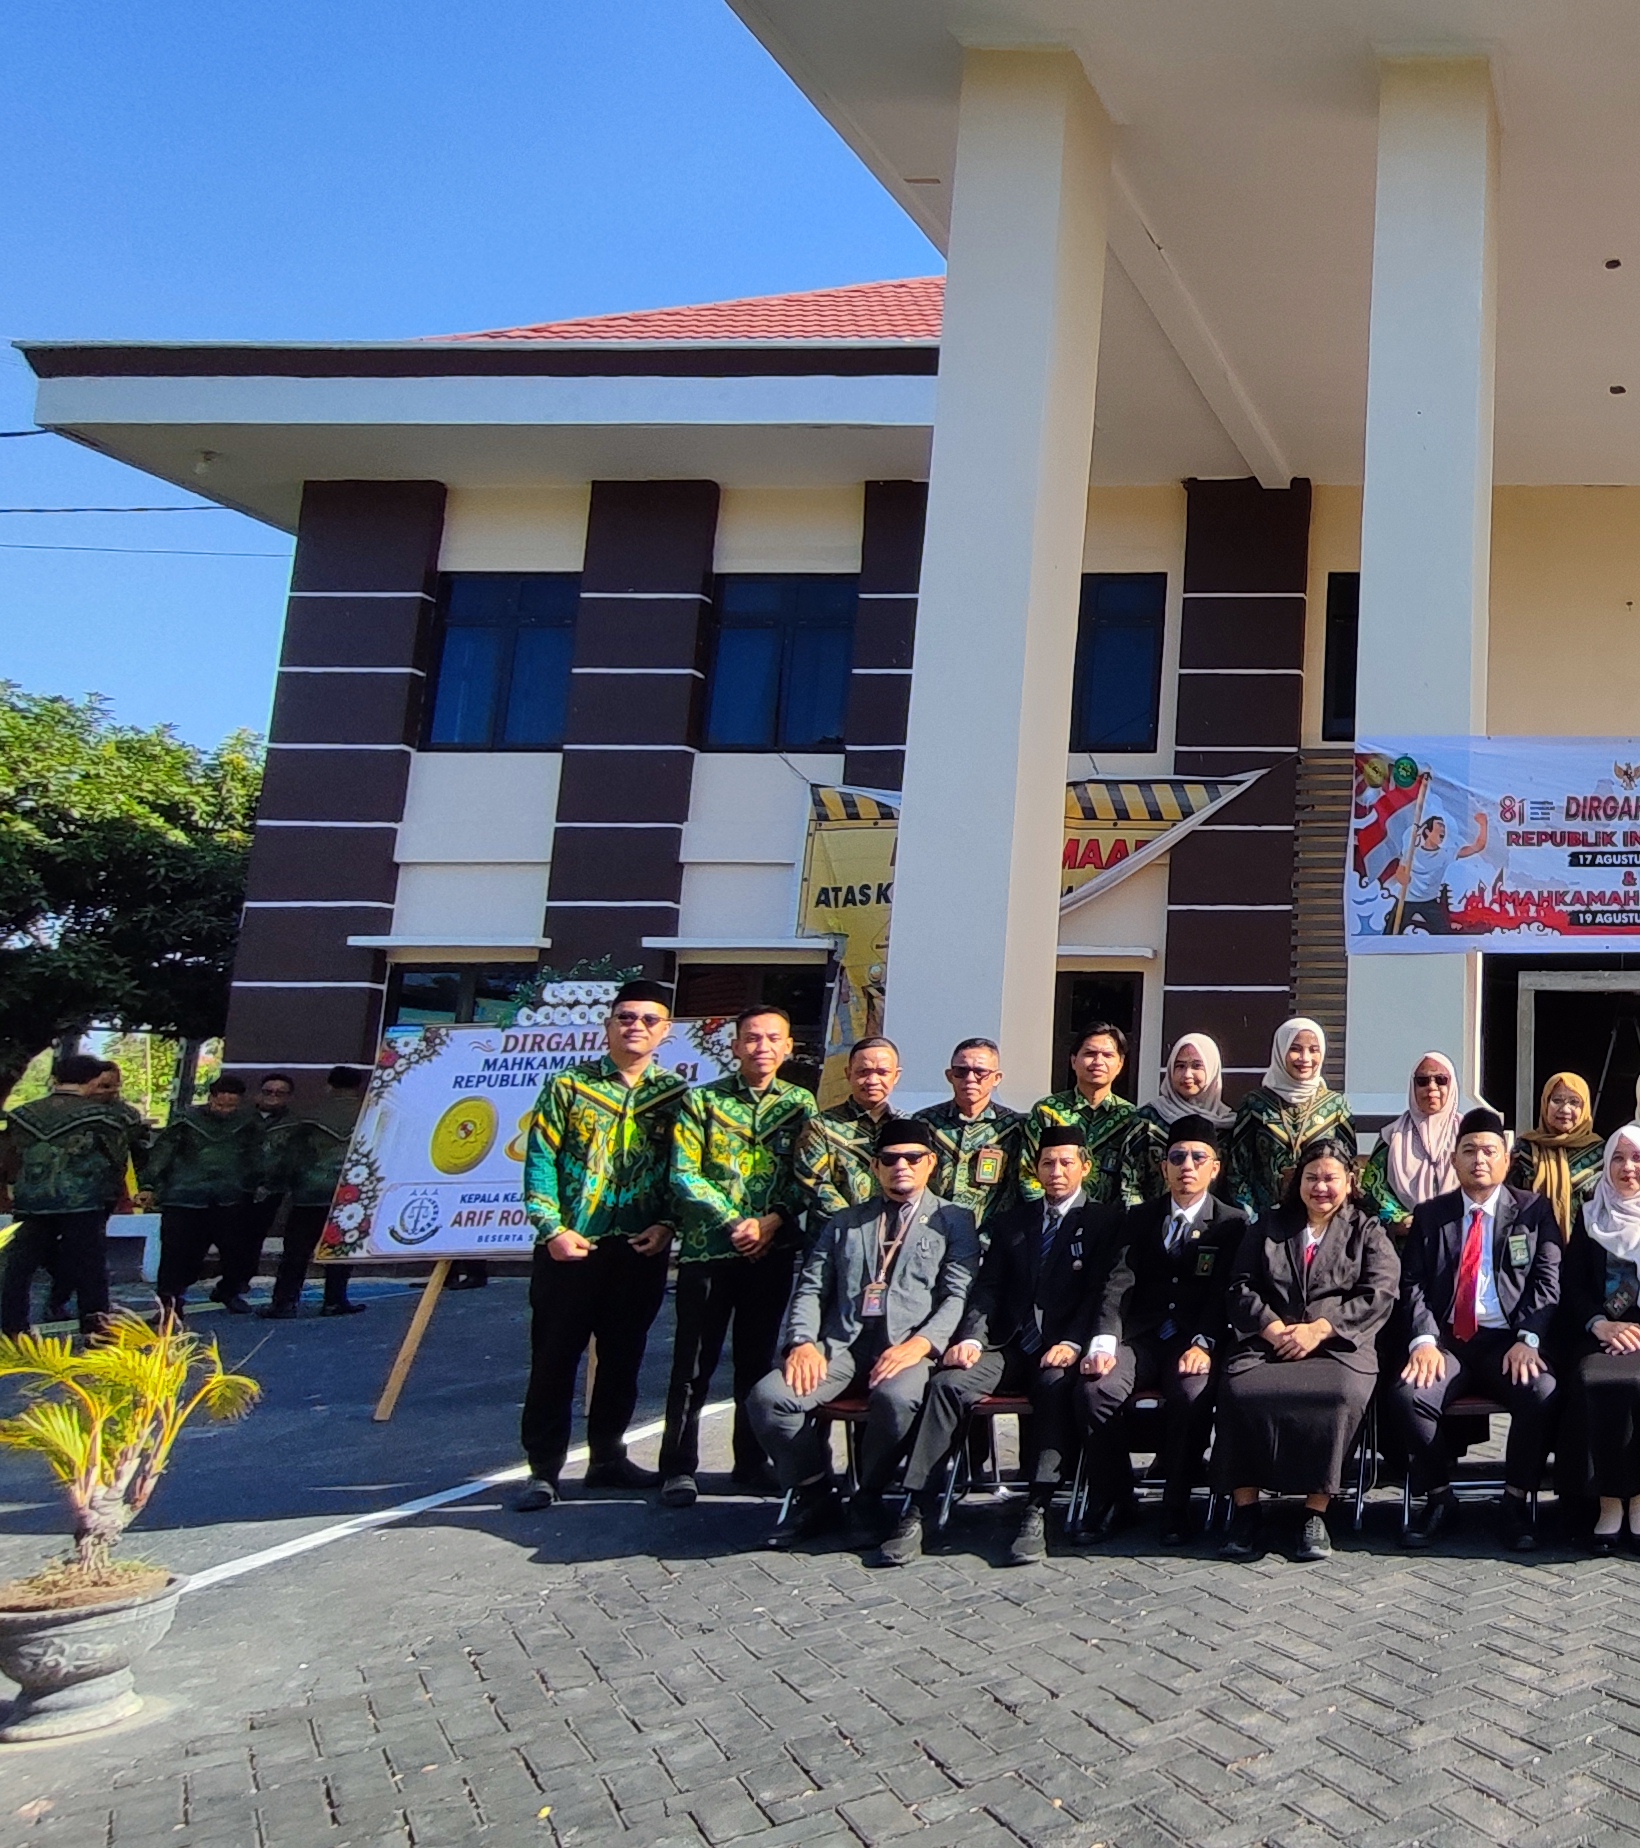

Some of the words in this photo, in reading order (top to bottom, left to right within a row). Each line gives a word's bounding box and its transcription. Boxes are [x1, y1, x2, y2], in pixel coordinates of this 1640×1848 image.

[1507, 831, 1617, 847] REPUBLIK
[1578, 853, 1593, 865] 17
[1621, 871, 1638, 886] &
[814, 883, 872, 908] ATAS
[1502, 890, 1639, 906] MAHKAMAH
[1578, 912, 1593, 924] 19
[502, 1032, 611, 1053] DIRGAHA
[452, 1073, 539, 1089] REPUBLIK
[460, 1194, 500, 1204] KEPALA
[450, 1210, 494, 1227] ARIF
[477, 1234, 523, 1242] BESERTA
